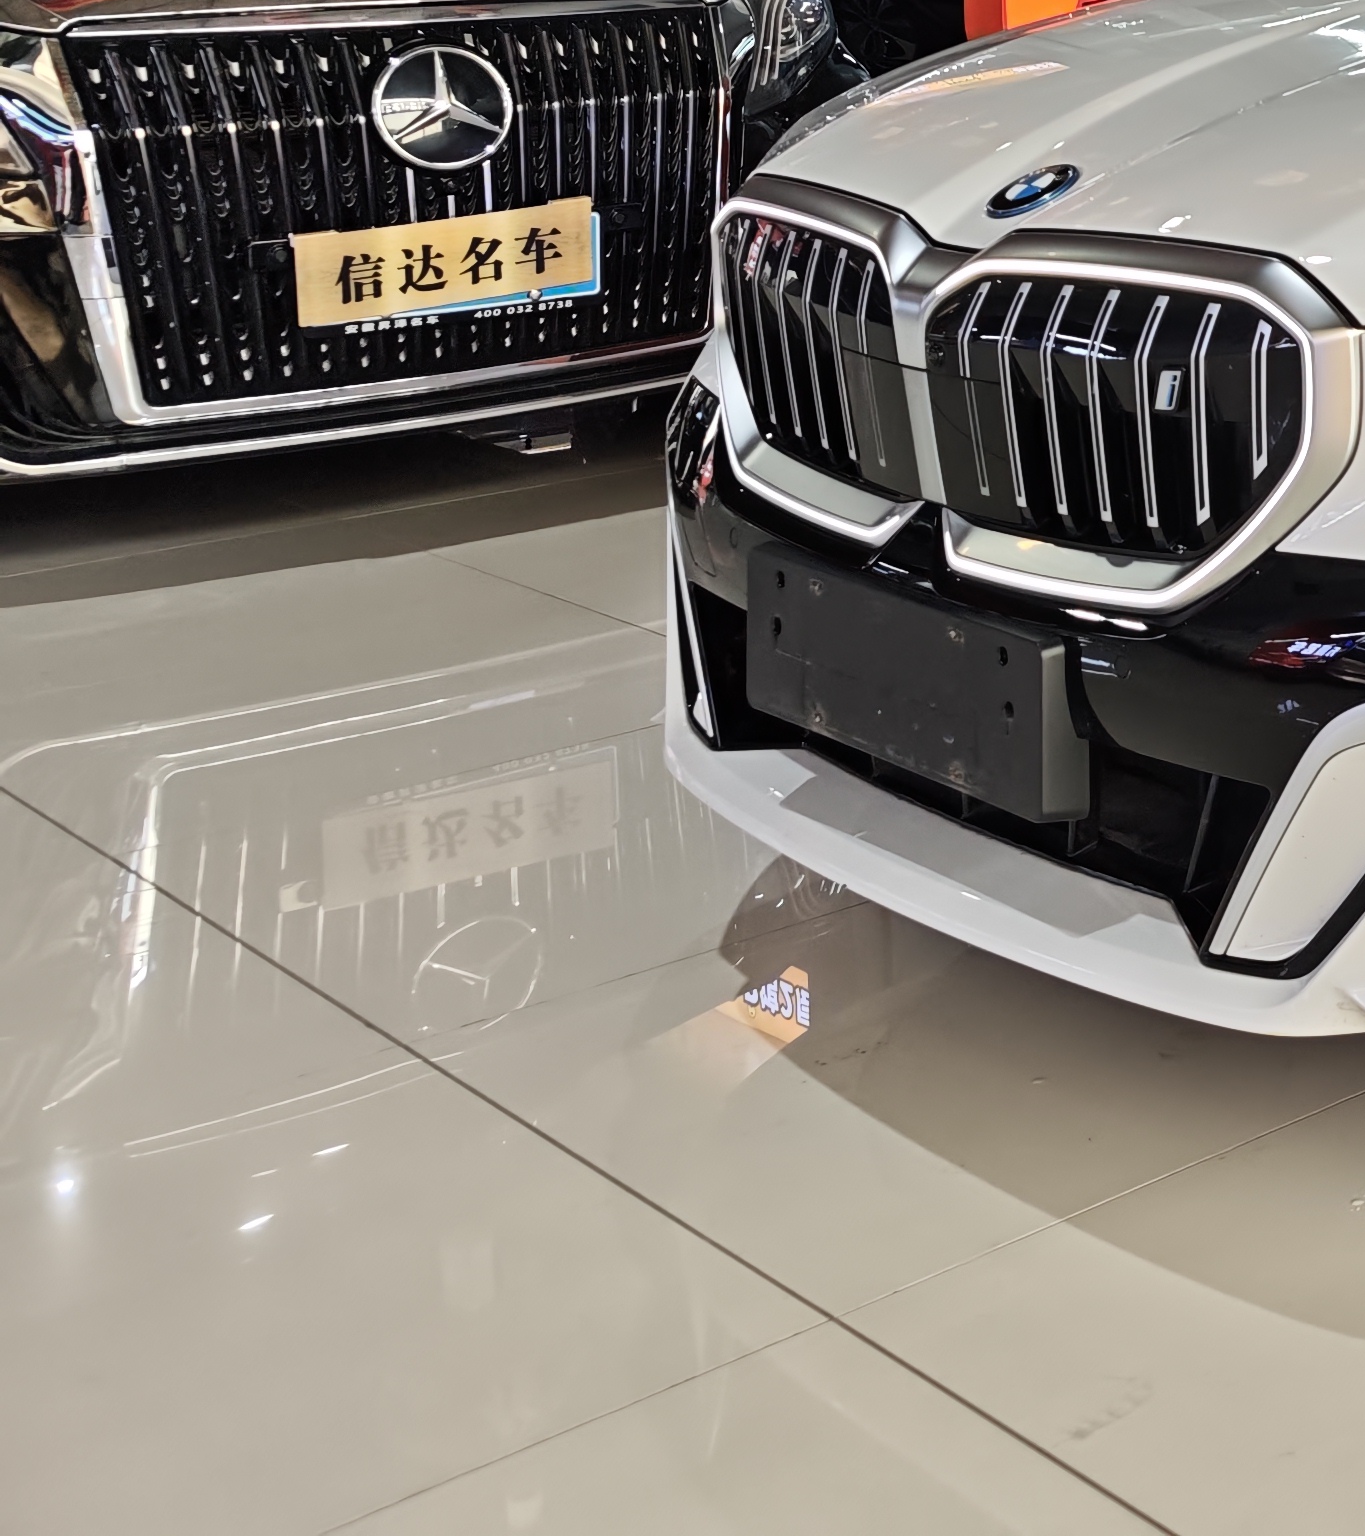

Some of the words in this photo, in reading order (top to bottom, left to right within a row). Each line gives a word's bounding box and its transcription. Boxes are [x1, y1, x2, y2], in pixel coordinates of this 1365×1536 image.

[336, 226, 565, 305] 信达名车
[474, 308, 502, 319] 400
[506, 304, 533, 314] 032
[538, 300, 573, 311] 8738
